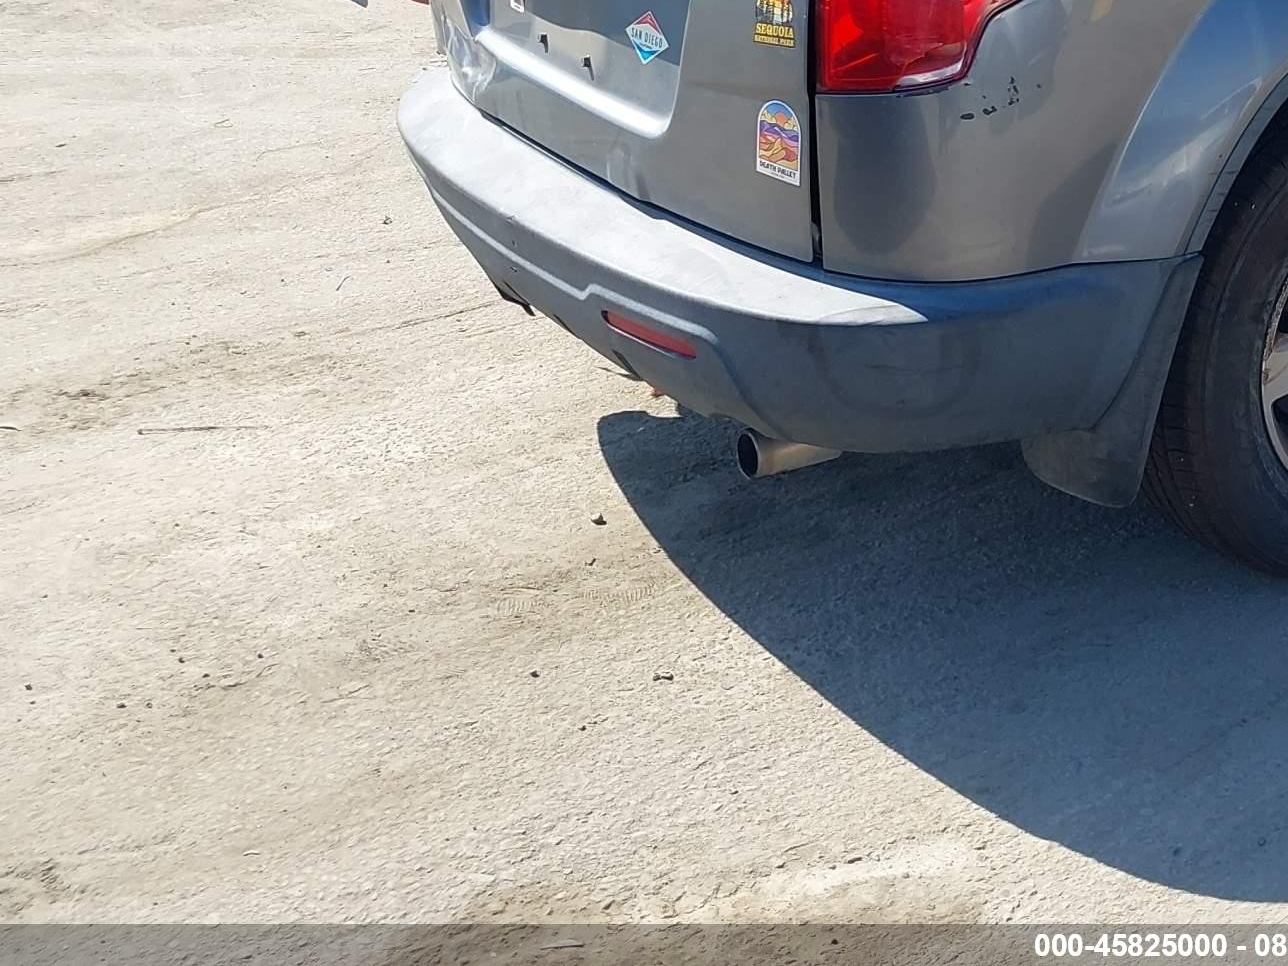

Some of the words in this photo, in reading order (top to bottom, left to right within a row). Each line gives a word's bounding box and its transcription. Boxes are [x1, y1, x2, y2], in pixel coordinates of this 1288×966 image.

[631, 27, 642, 40] SAN
[645, 33, 663, 48] DIEGO
[756, 23, 794, 38] SEQUOIA
[760, 160, 776, 172] DEATH
[778, 167, 796, 178] VALLEY
